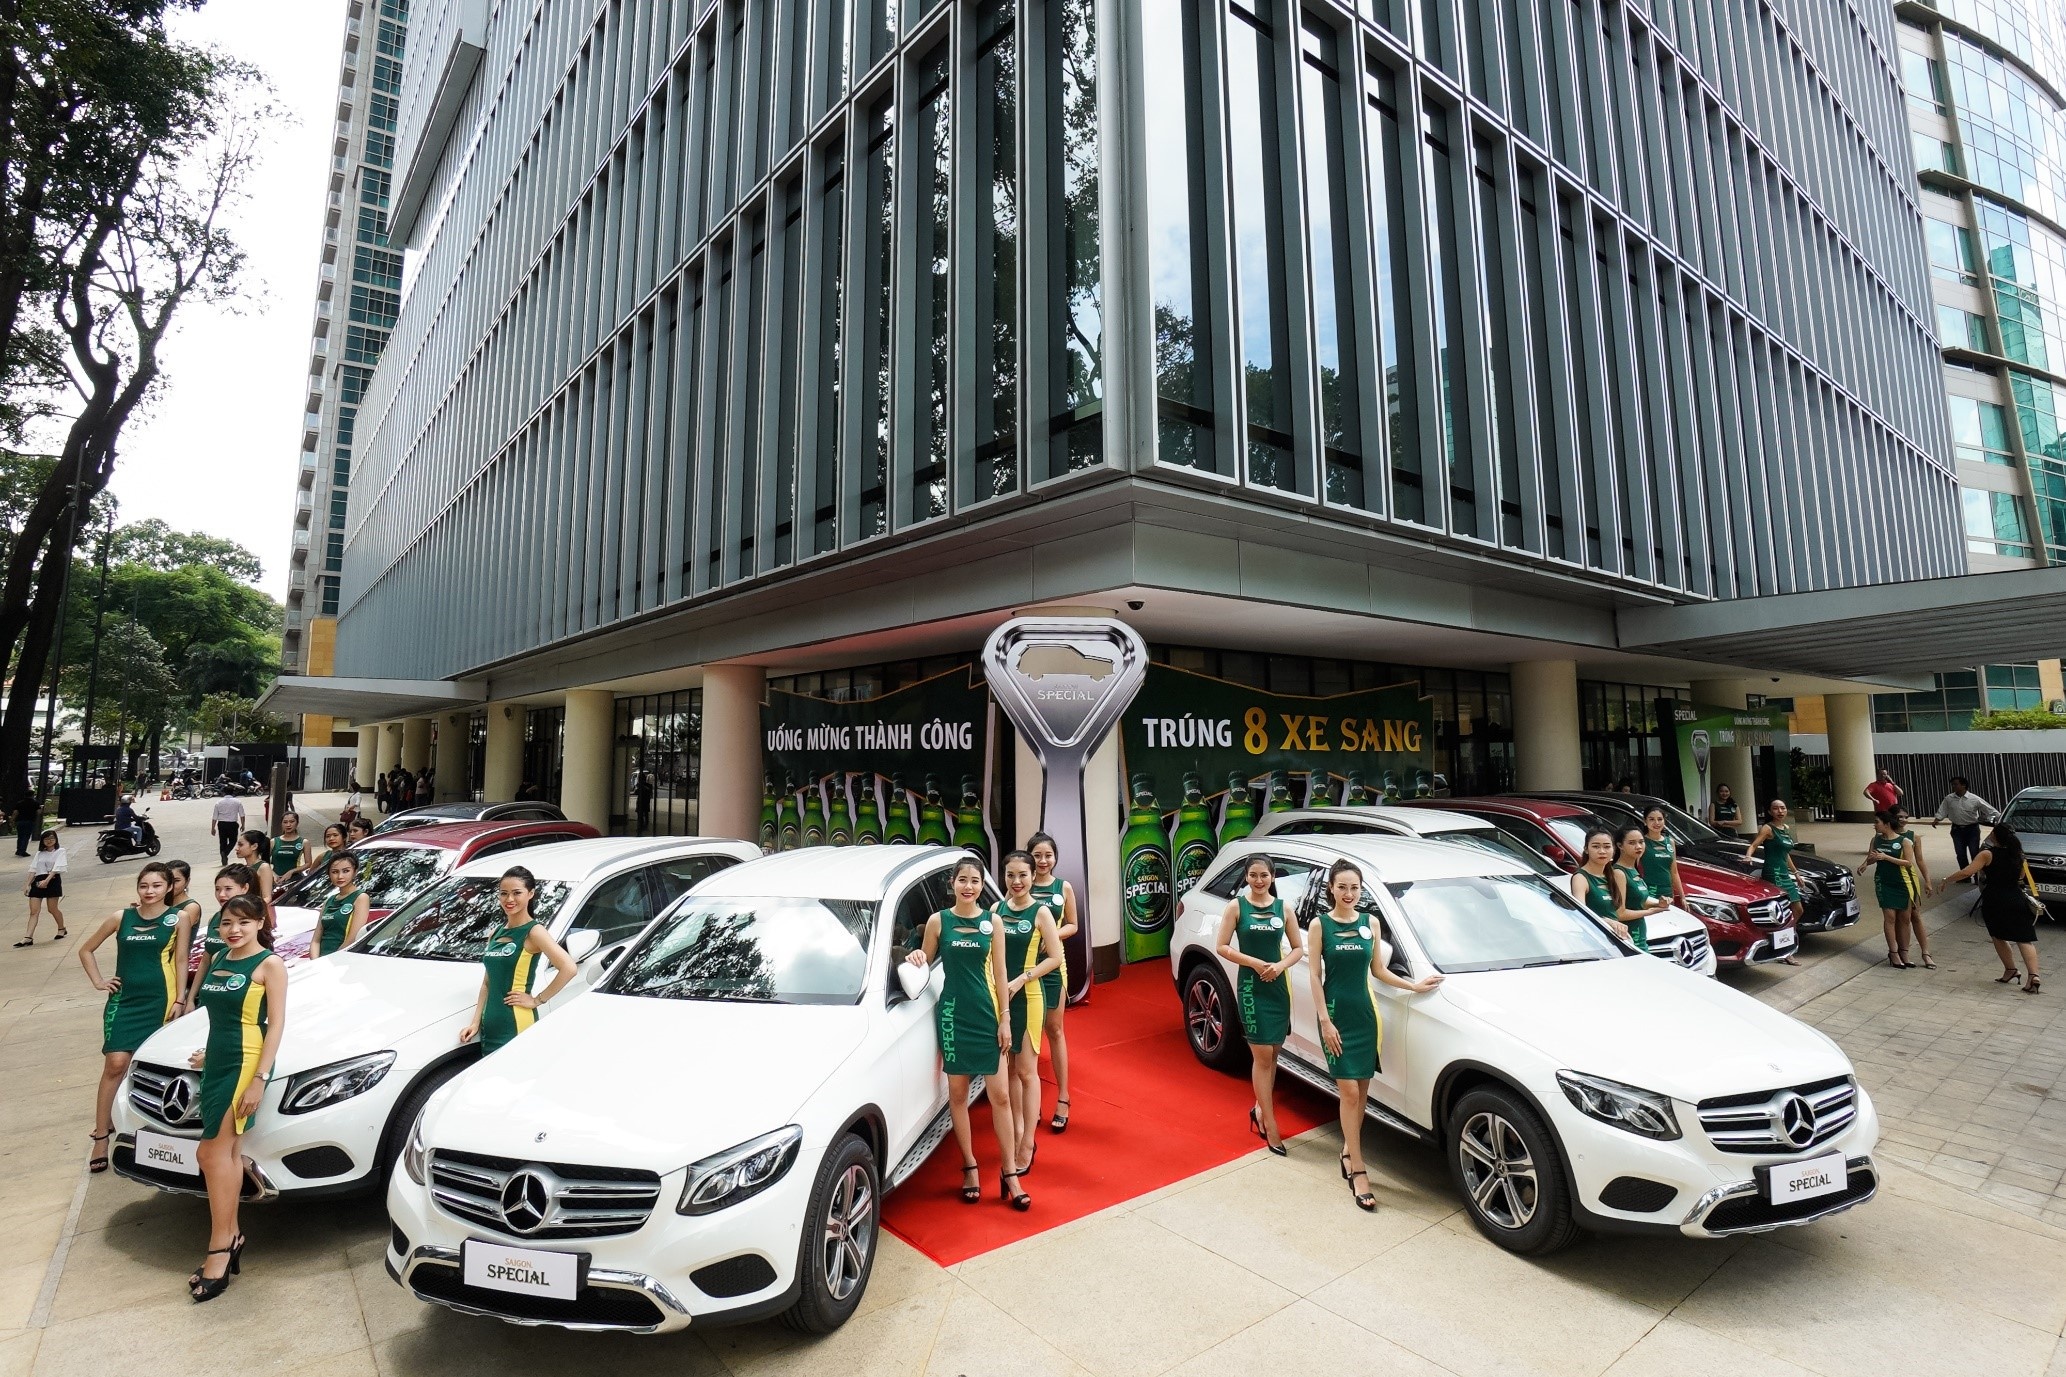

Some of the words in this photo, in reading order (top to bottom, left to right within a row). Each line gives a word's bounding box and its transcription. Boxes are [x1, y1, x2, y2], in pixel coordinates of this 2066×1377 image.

[1037, 689, 1095, 700] SPECIAL
[767, 723, 802, 751] UỐNG
[807, 723, 850, 750] MỪNG
[855, 719, 912, 750] THÀNH
[920, 717, 972, 750] CÔNG
[1142, 713, 1232, 747] TRÚNG
[1244, 706, 1268, 754] 8
[1280, 714, 1331, 751] XE
[1340, 718, 1422, 752] SANG
[1137, 874, 1159, 883] SAIGON
[1126, 882, 1170, 899] SPECIAL
[202, 983, 228, 992] SPECIAL
[1244, 975, 1257, 1034] SPECIAL
[942, 997, 956, 1063] SPECIAL
[148, 1148, 184, 1164] SPECIAL
[1789, 1174, 1831, 1192] SPECIAL
[487, 1263, 551, 1286] SPECIAL
